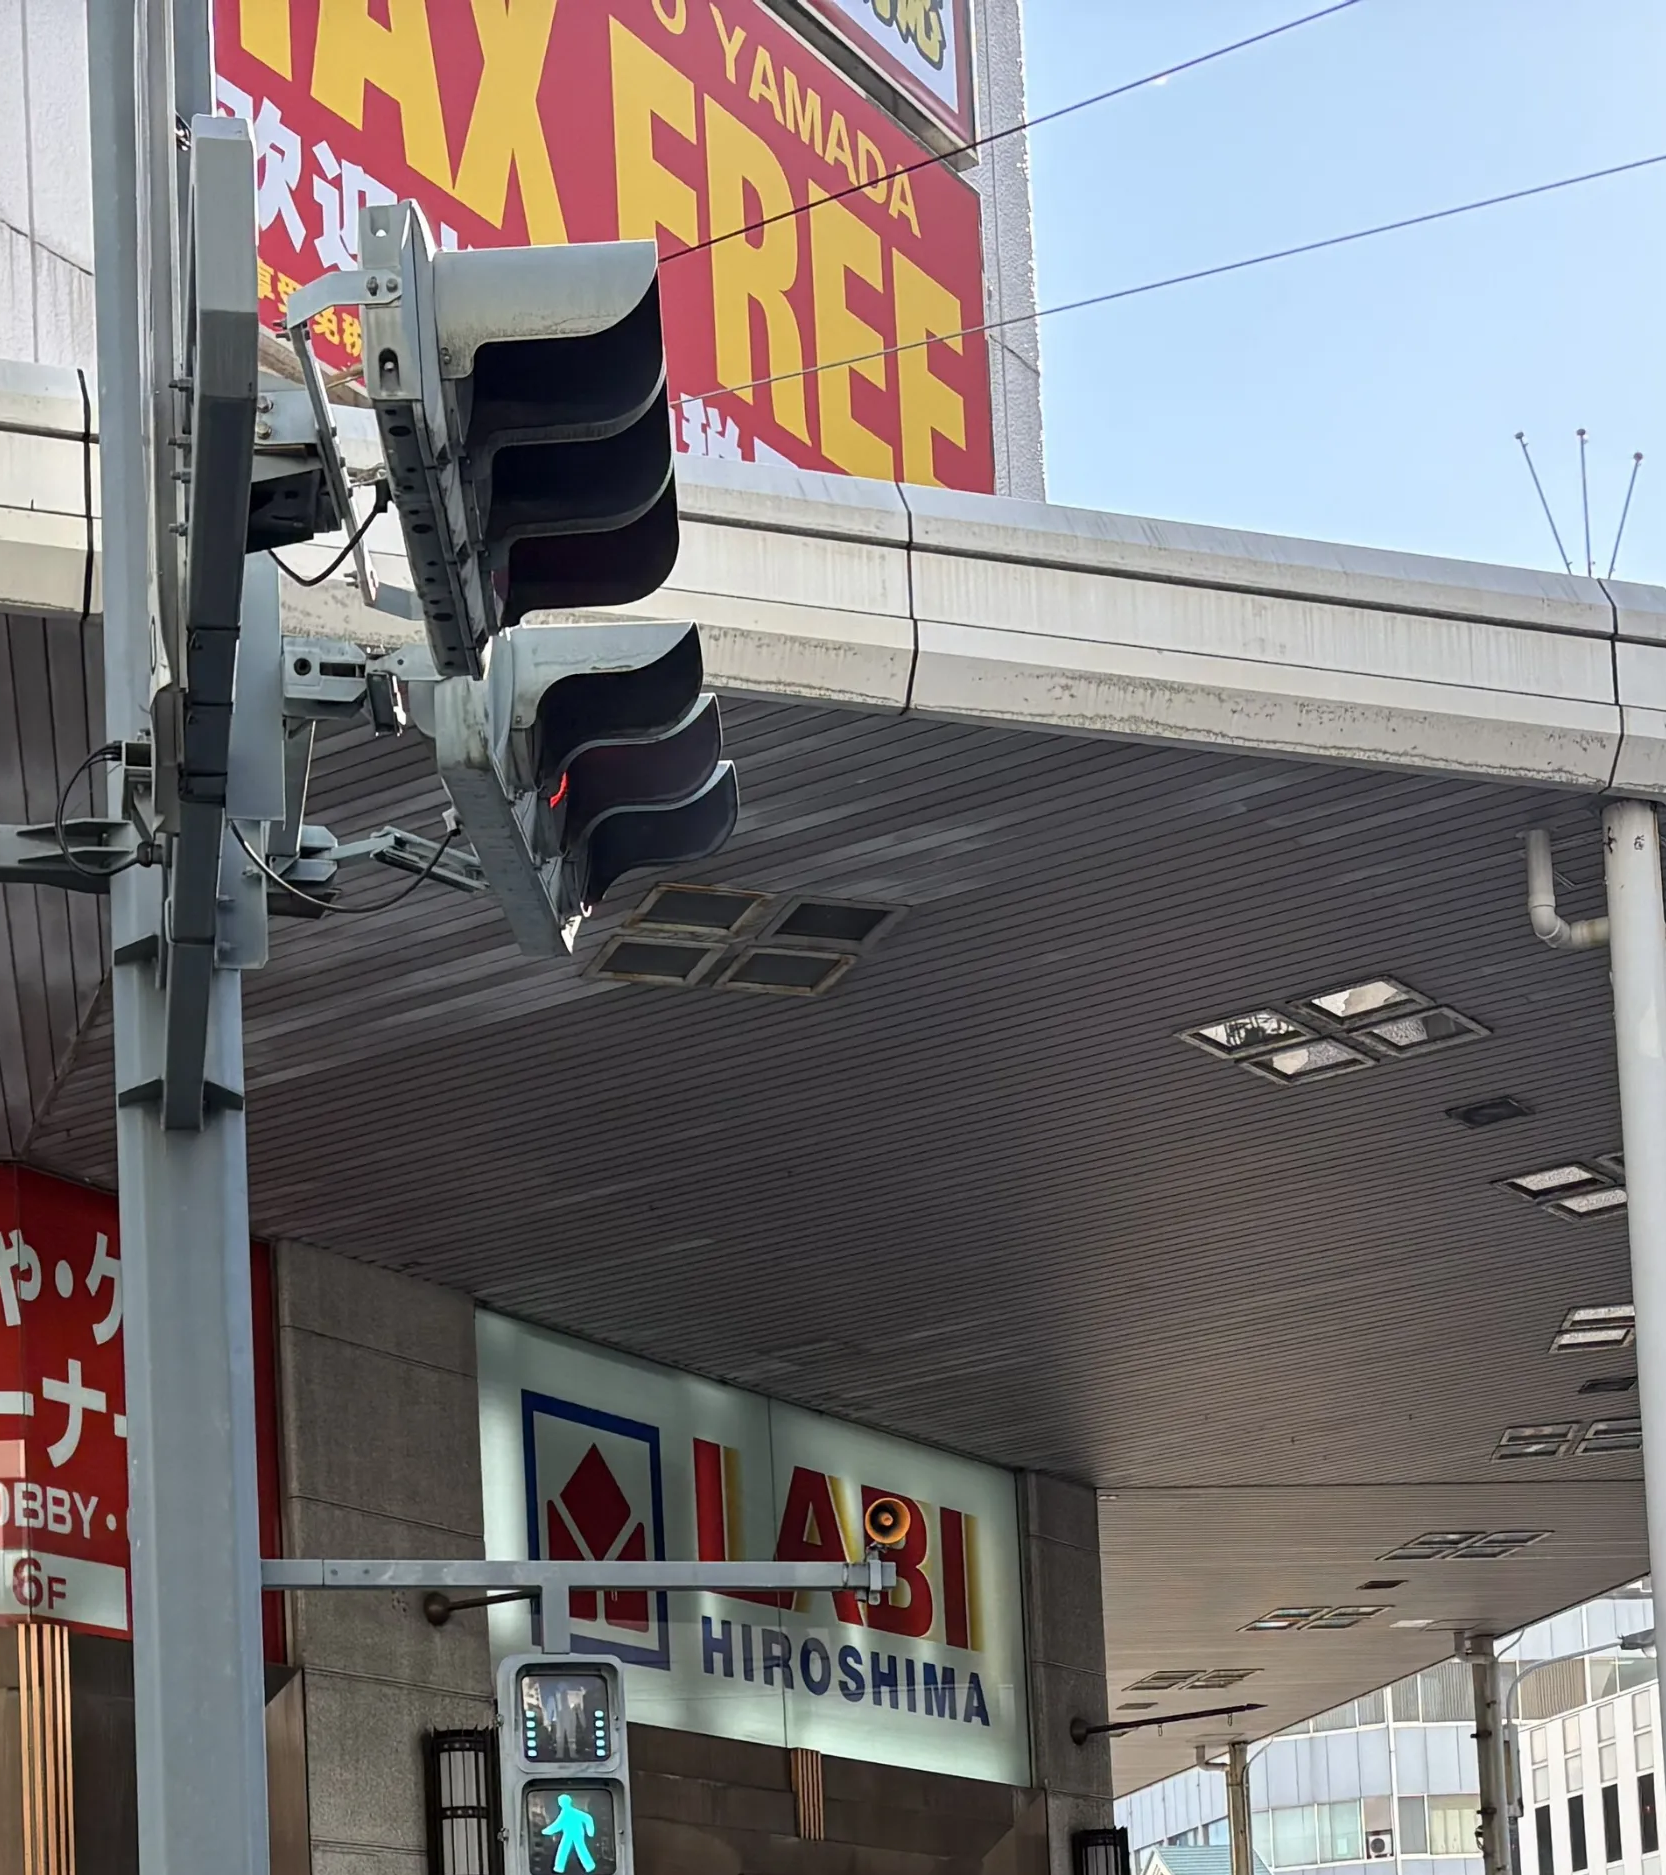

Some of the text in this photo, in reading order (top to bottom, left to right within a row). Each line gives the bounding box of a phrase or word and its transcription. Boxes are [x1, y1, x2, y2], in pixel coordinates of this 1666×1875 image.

[239, 0, 570, 245] AX
[709, 2, 921, 238] YAMADA
[12, 1556, 68, 1611] 6F
[693, 1437, 975, 1650] LABI
[701, 1615, 991, 1727] HIROSHIMA
